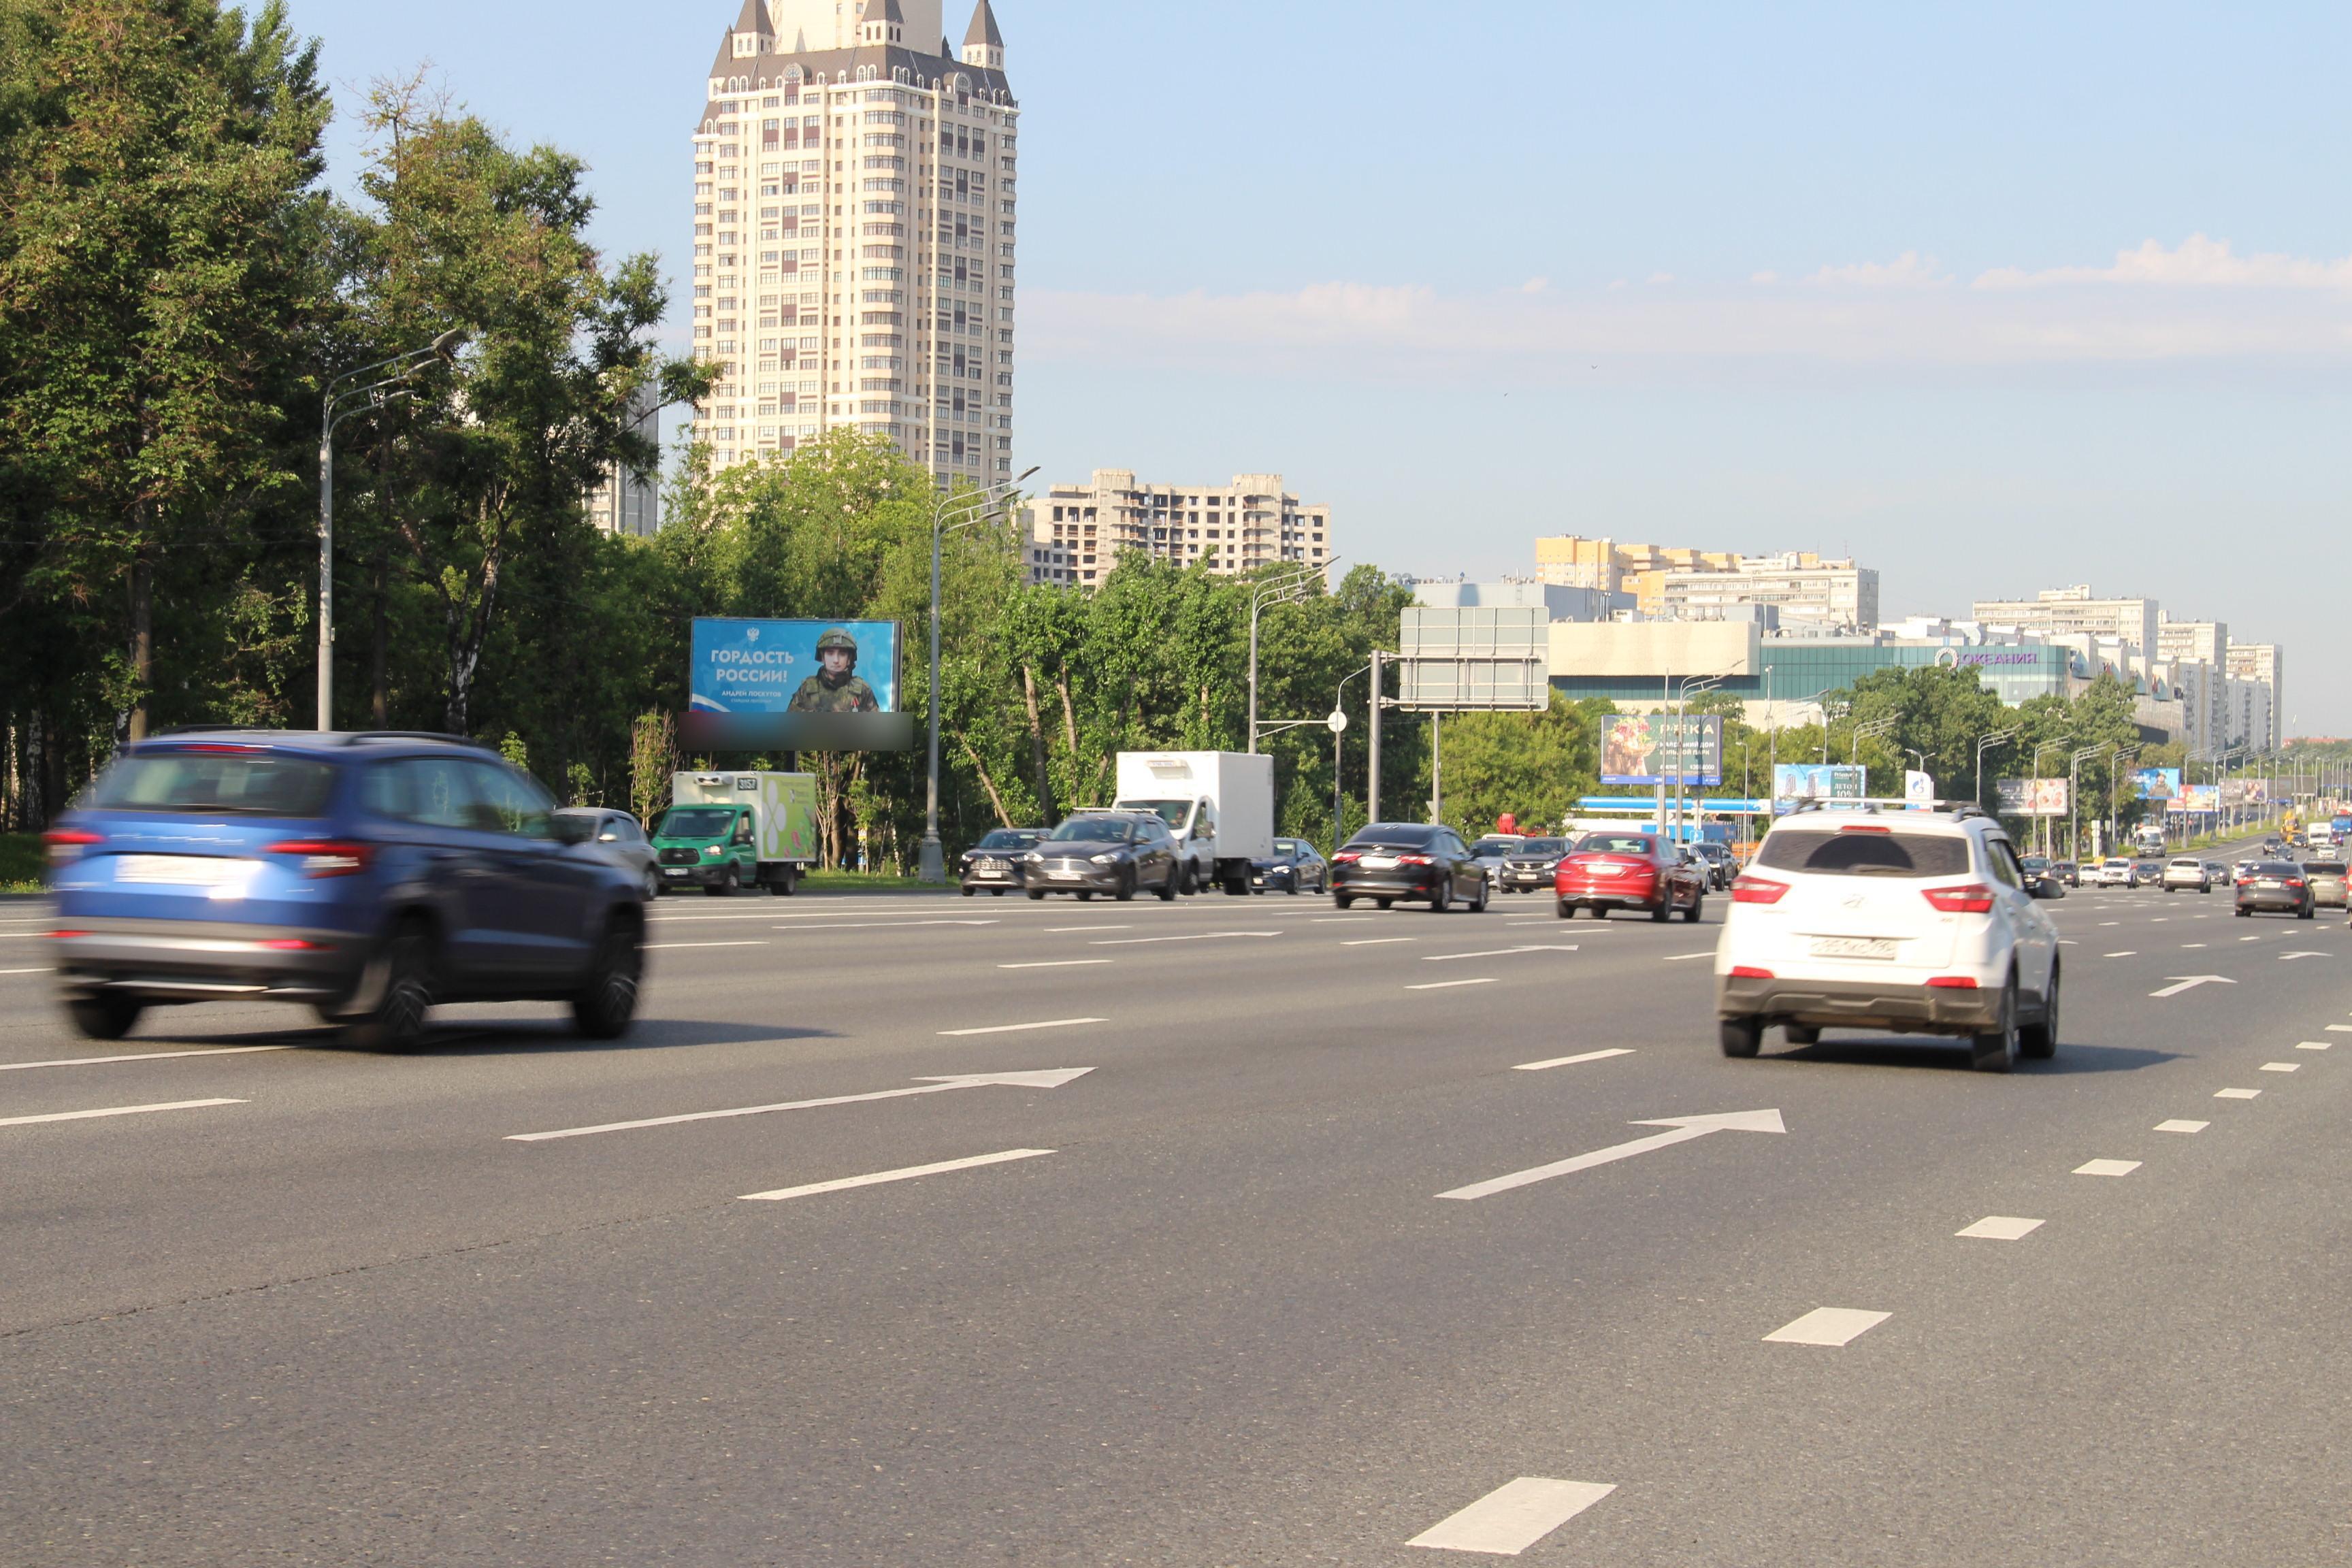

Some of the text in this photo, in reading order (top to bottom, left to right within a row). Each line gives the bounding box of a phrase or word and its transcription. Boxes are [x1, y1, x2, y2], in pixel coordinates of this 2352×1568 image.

[711, 650, 794, 664] ГОРДОСТЬ
[1962, 653, 2037, 665] ОКЕАНИЯ
[717, 669, 787, 683] РОССИИ!
